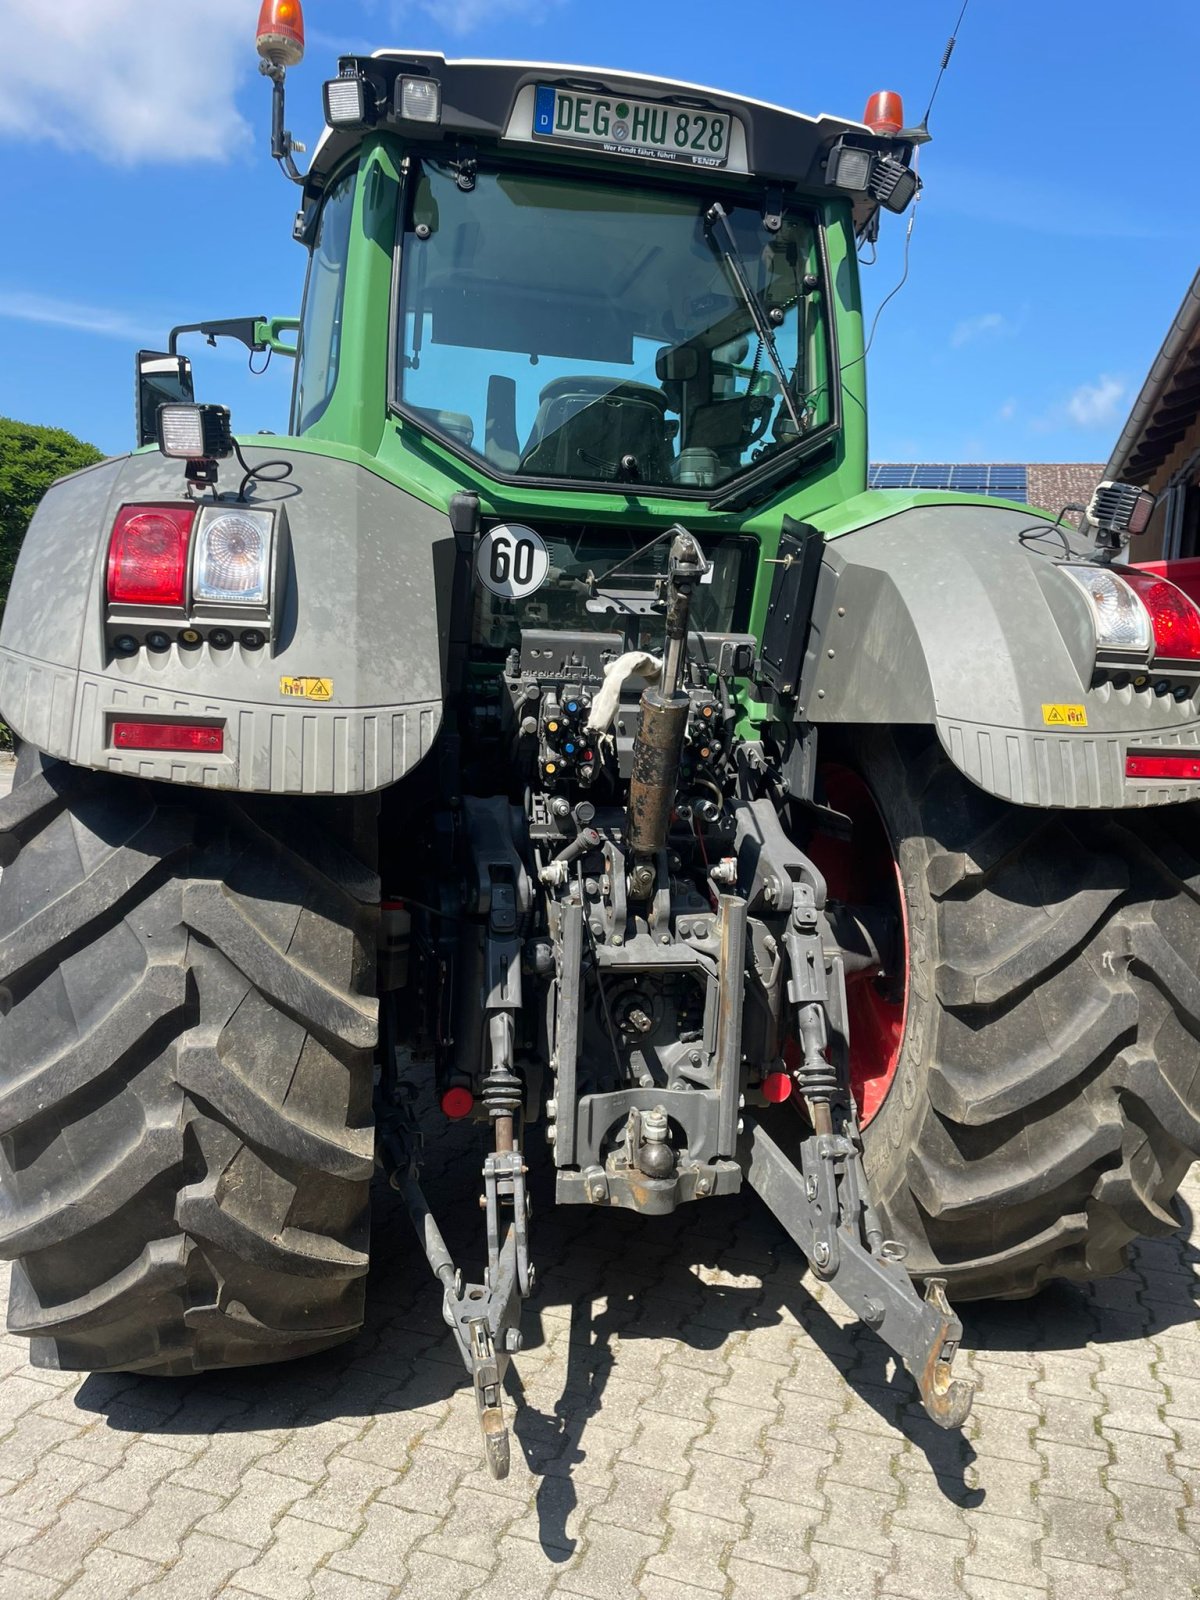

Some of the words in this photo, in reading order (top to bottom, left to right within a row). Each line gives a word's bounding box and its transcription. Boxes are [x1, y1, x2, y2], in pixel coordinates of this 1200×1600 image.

[541, 114, 548, 126] D
[556, 95, 611, 136] DEG
[631, 106, 668, 145] HU
[673, 113, 724, 152] 828
[603, 144, 617, 152] Wer
[617, 146, 637, 155] Fendt
[637, 147, 656, 157] fährt,
[656, 150, 676, 160] führt!
[692, 156, 722, 167] FENDT
[490, 537, 535, 585] 60
